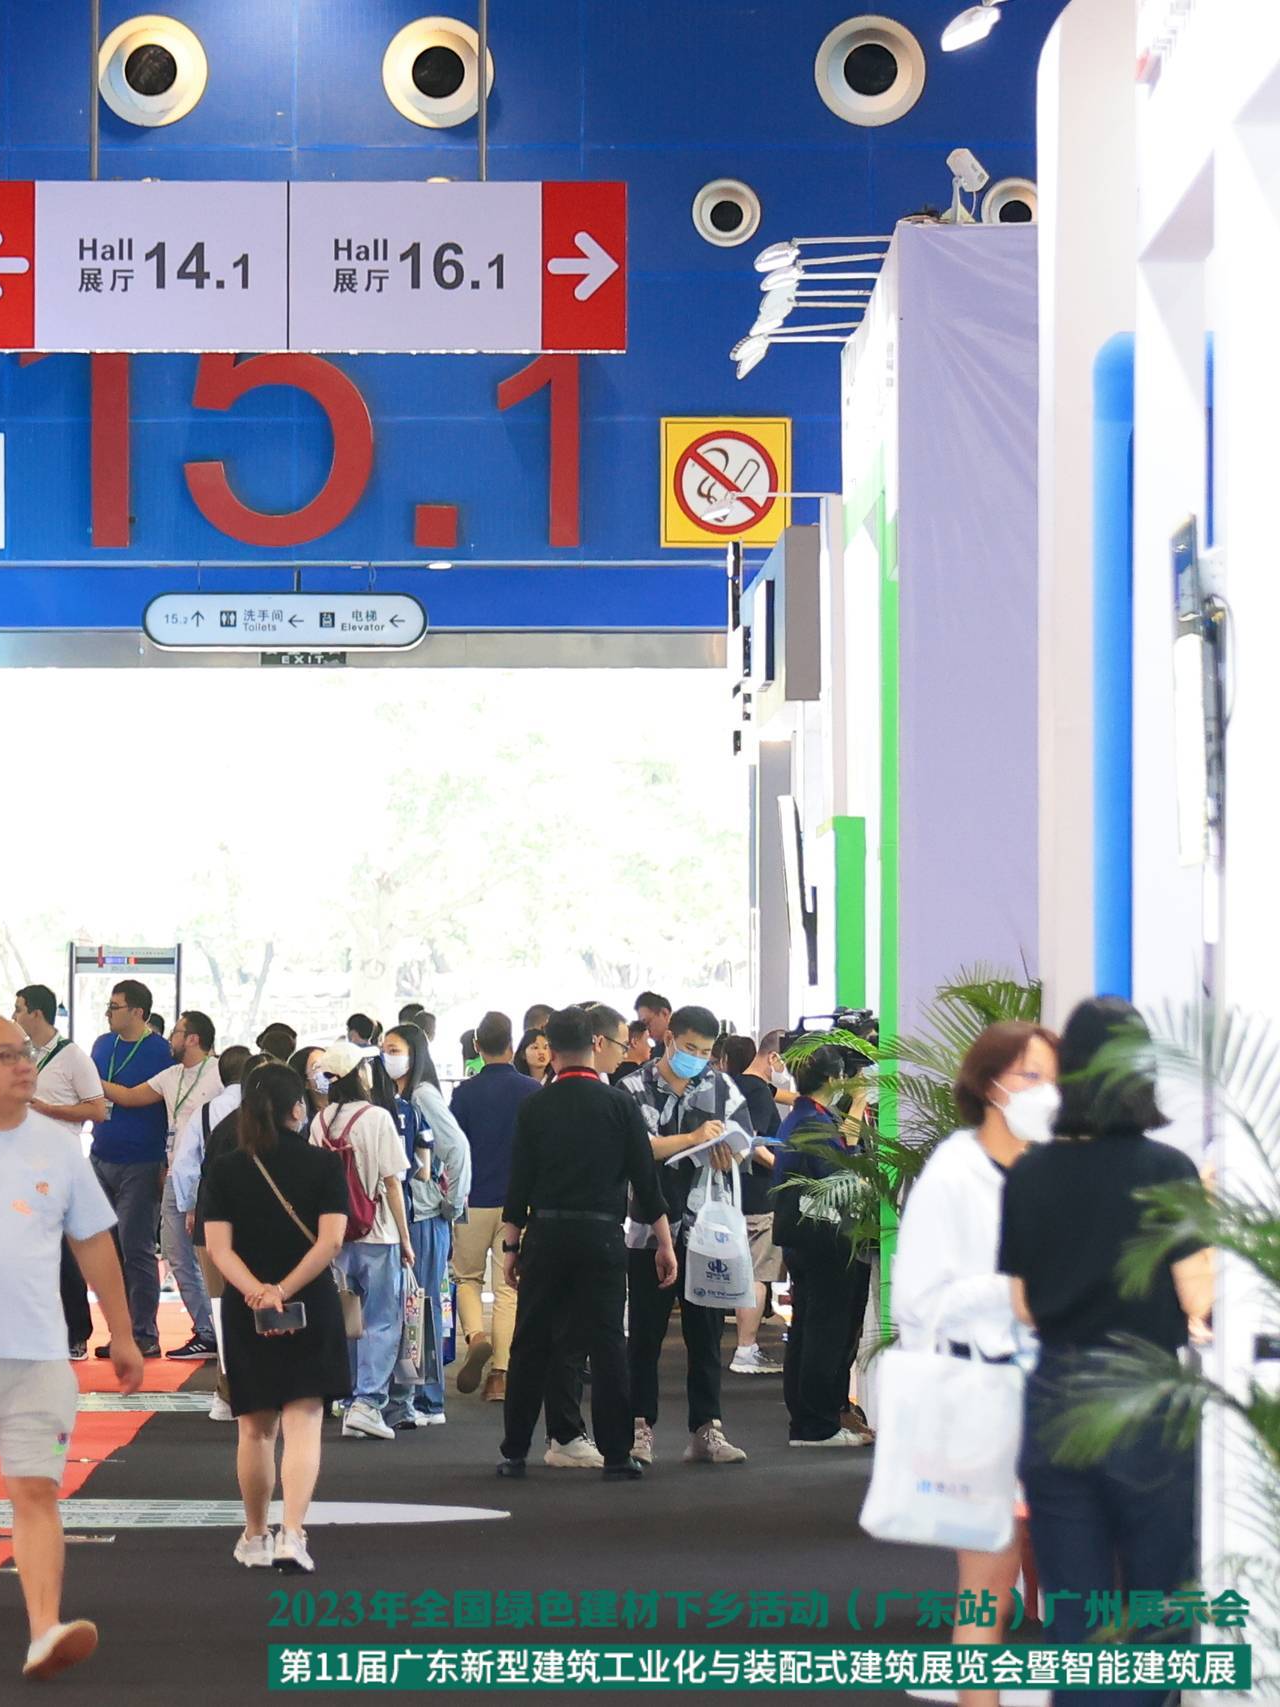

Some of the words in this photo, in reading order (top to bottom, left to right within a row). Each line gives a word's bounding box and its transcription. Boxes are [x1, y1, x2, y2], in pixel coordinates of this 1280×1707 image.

[78, 238, 134, 261] Hall
[144, 241, 250, 290] 14.1
[333, 238, 389, 261] Hall
[399, 241, 505, 290] 16.1
[78, 268, 135, 293] 展厅
[333, 268, 390, 293] 展厅
[18, 352, 581, 550] 15.1
[164, 613, 189, 625] 15.2
[243, 609, 284, 622] 洗手间
[352, 609, 378, 622] 电梯
[244, 622, 277, 632] Toilets
[341, 623, 385, 632] Elevator
[281, 654, 325, 665] EXIT
